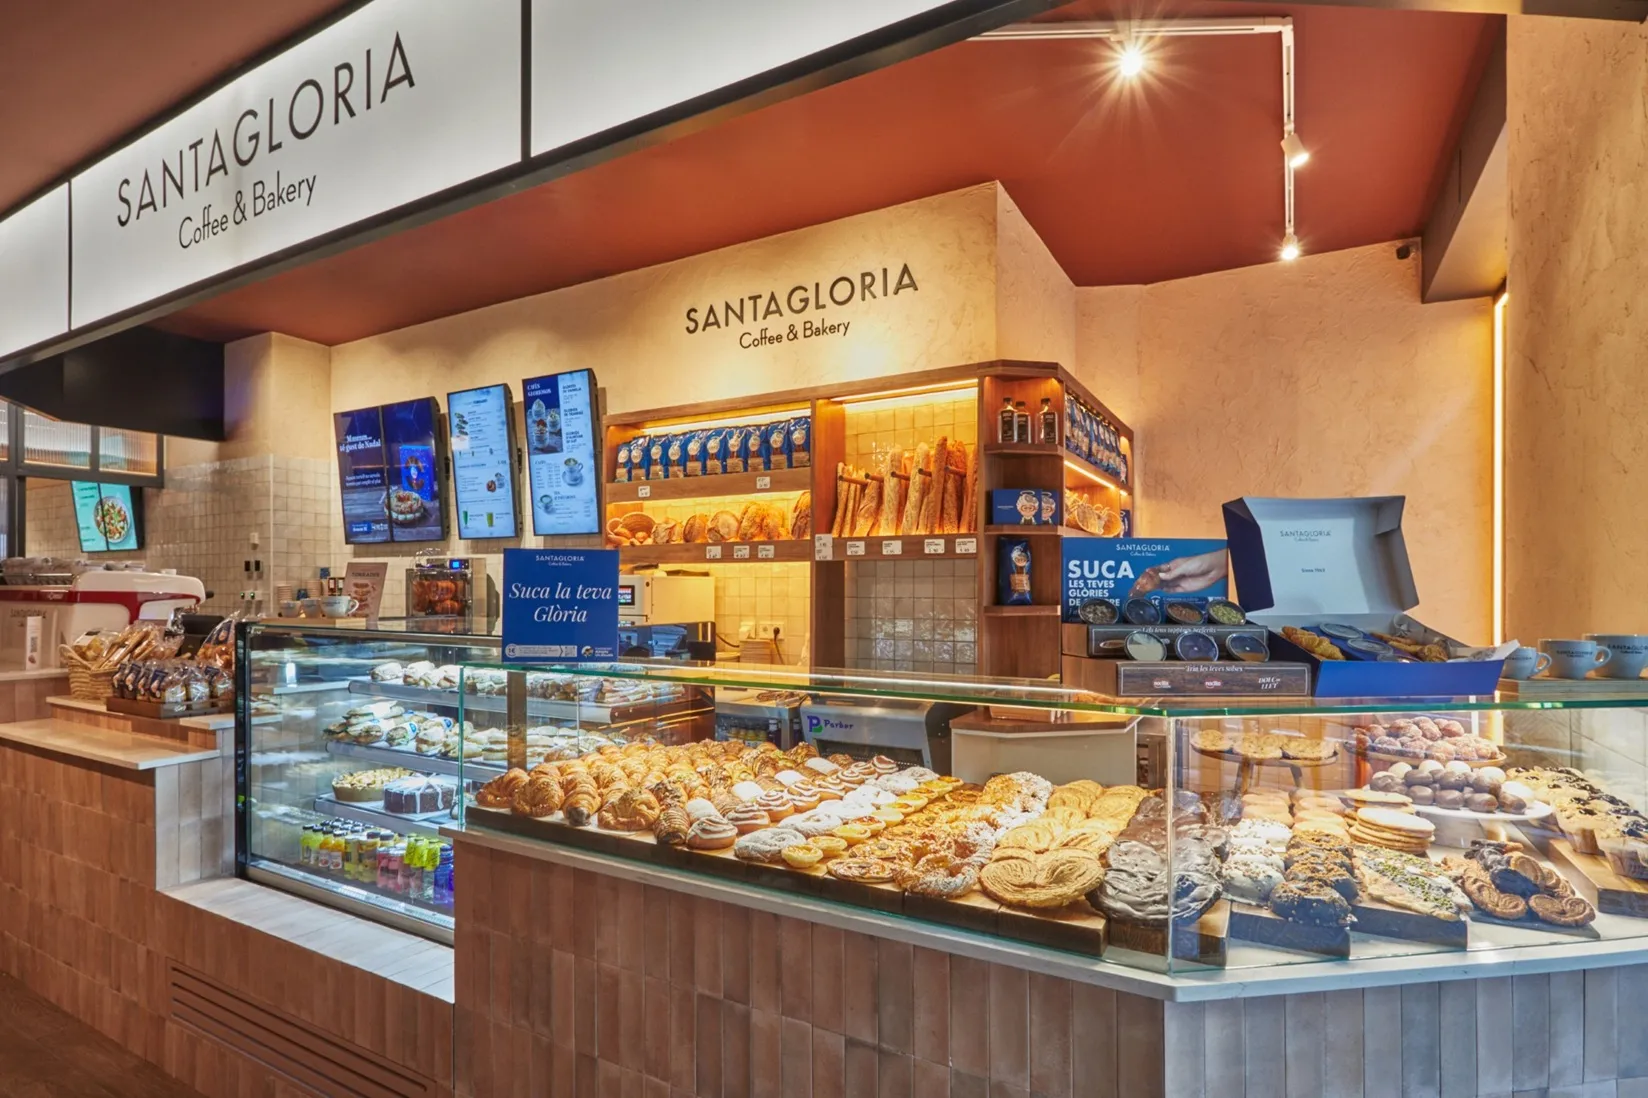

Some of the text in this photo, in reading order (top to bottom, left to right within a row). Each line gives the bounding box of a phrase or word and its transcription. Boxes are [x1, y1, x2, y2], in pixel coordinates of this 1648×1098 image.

[117, 31, 415, 228] SANTAGLORIA
[179, 171, 317, 250] Coffee & Bakery
[685, 263, 919, 335] SANTAGLORIA
[739, 318, 850, 349] Coffee & Bakery
[1068, 560, 1135, 578] SUCA
[509, 582, 612, 599] Suca la teva
[1068, 587, 1109, 598] GLÒRIES
[1069, 580, 1115, 588] LES TEVES
[1068, 599, 1081, 607] DE
[533, 604, 587, 622] Glòria
